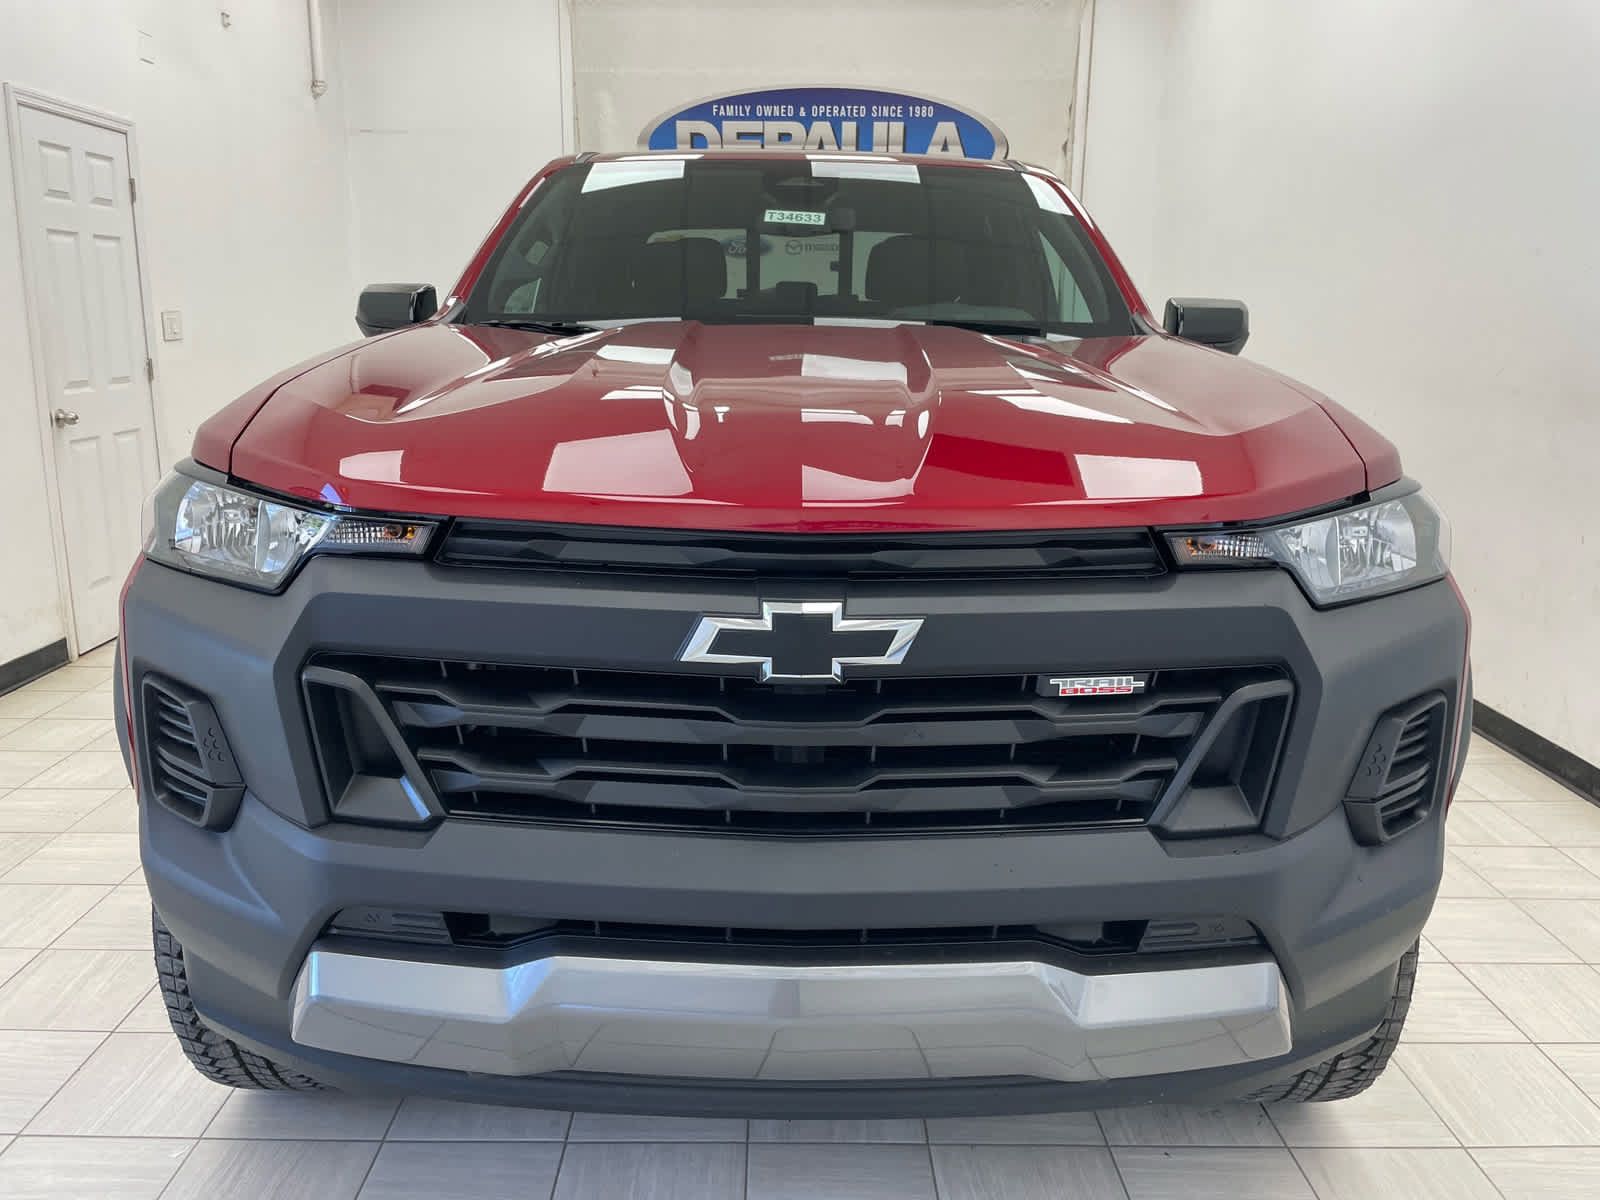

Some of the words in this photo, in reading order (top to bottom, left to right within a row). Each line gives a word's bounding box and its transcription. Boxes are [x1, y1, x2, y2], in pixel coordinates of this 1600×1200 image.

[712, 104, 751, 117] FAMILY
[756, 104, 794, 117] OWNED
[799, 106, 807, 117] &
[811, 105, 866, 118] OPERATED
[871, 105, 903, 118] SINCE
[908, 105, 934, 118] 1980
[767, 211, 822, 223] T34633
[1050, 676, 1144, 688] TRAIL
[1060, 686, 1132, 696] BOSS
